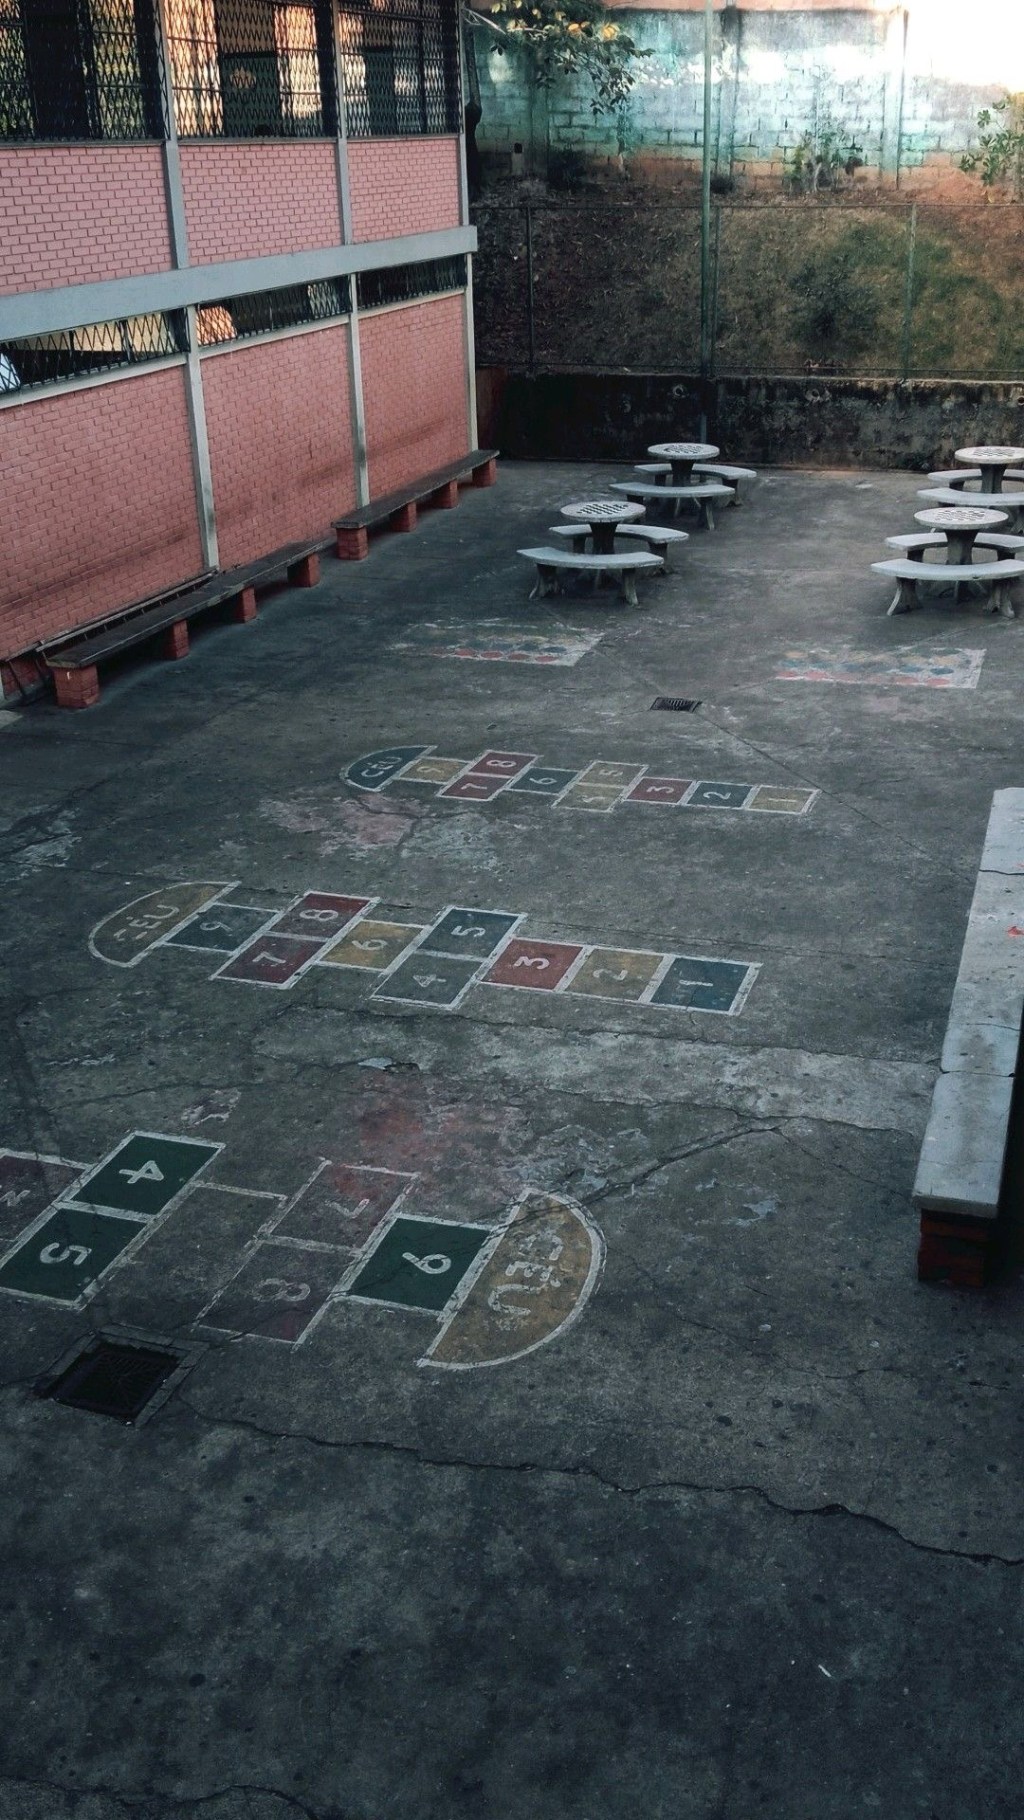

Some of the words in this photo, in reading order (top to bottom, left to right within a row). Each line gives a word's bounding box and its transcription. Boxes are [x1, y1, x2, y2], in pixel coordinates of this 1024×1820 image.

[486, 759, 517, 768] 8
[460, 782, 488, 790] 7
[528, 776, 557, 785] 6
[646, 785, 674, 794] 3
[703, 791, 731, 800] 2
[299, 908, 339, 920] 8
[199, 920, 233, 936] 9
[450, 925, 486, 938] 5
[352, 939, 388, 951] 6
[252, 951, 286, 964] 7
[514, 956, 550, 970] 3
[412, 974, 446, 988] 4
[592, 968, 628, 981] 2
[680, 979, 714, 987] 1
[119, 1160, 165, 1184] 4
[324, 1198, 370, 1219] 7
[40, 1242, 92, 1266] 5
[402, 1252, 452, 1275] 9
[251, 1278, 311, 1302] 8
